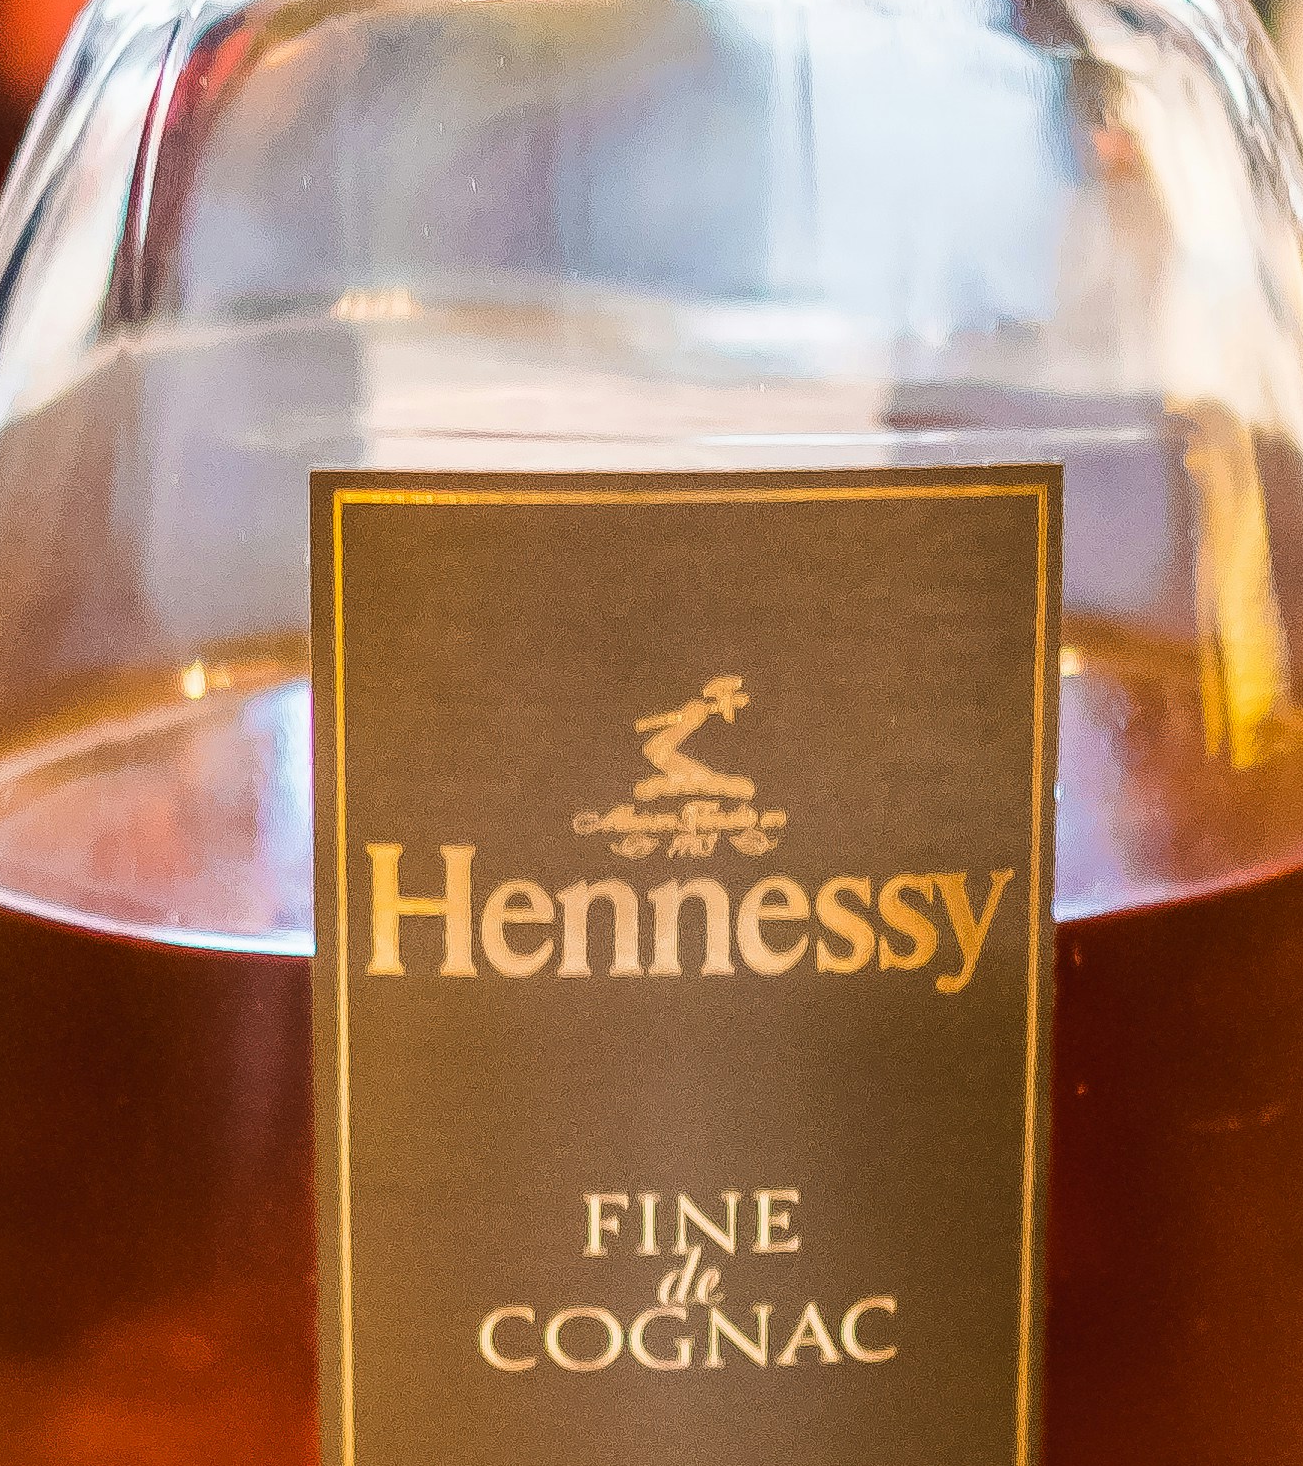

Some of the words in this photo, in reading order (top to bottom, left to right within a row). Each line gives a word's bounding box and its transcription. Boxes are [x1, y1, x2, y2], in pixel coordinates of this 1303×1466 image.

[365, 842, 1015, 994] Hennessy
[582, 1187, 801, 1257] FINE
[656, 1245, 725, 1307] de
[478, 1294, 898, 1372] COGNAC
